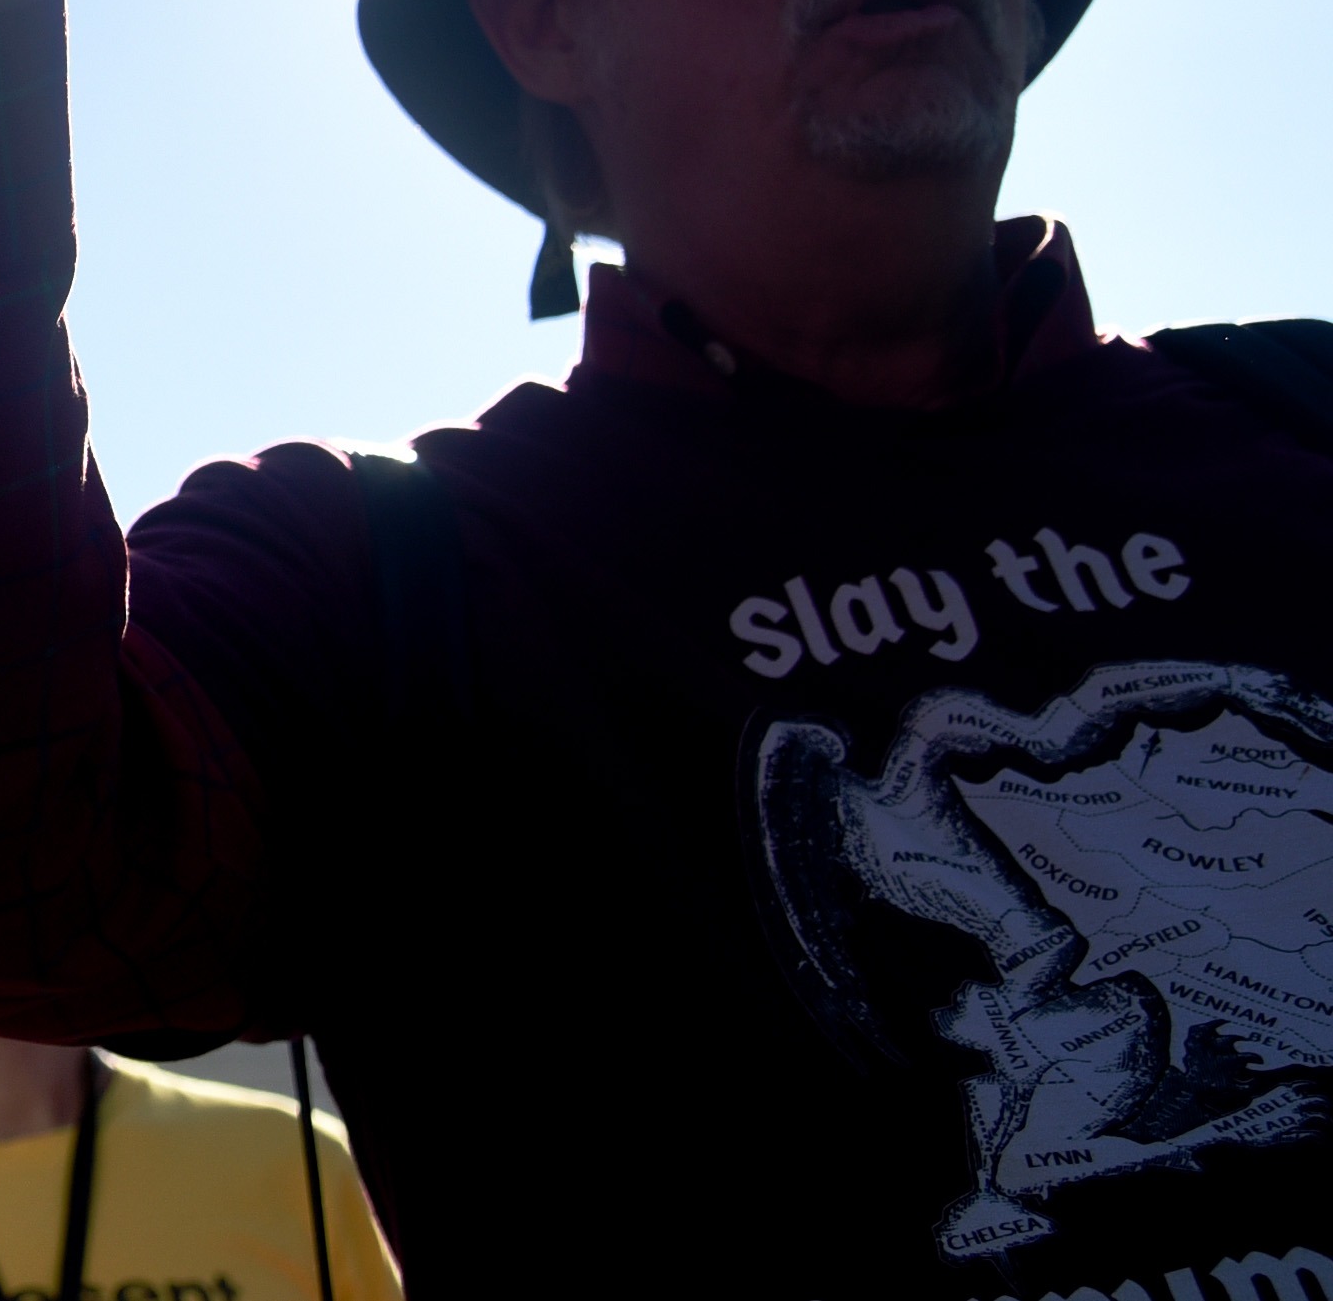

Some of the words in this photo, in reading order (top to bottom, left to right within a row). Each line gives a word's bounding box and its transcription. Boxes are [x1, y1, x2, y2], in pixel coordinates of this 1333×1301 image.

[729, 566, 979, 679] slay
[984, 527, 1191, 613] the
[1101, 671, 1214, 699] AMESBURY
[999, 780, 1122, 805] BRADFORD
[1175, 774, 1298, 799] NEWBURY
[1142, 837, 1265, 872] ROWLEY
[998, 927, 1073, 974] MIDDLETON
[1088, 919, 1201, 972] TOPSFIELD
[1169, 981, 1278, 1028] WENHAM
[1203, 961, 1333, 1016] HAMILTON
[978, 991, 1029, 1070] LYNNFIELD
[1060, 1010, 1142, 1053] DANVERS
[1211, 1091, 1295, 1133] MARBLE
[1235, 1115, 1296, 1141] HEAD
[1025, 1149, 1093, 1169] LYNN
[946, 1216, 1044, 1251] CHELSEA
